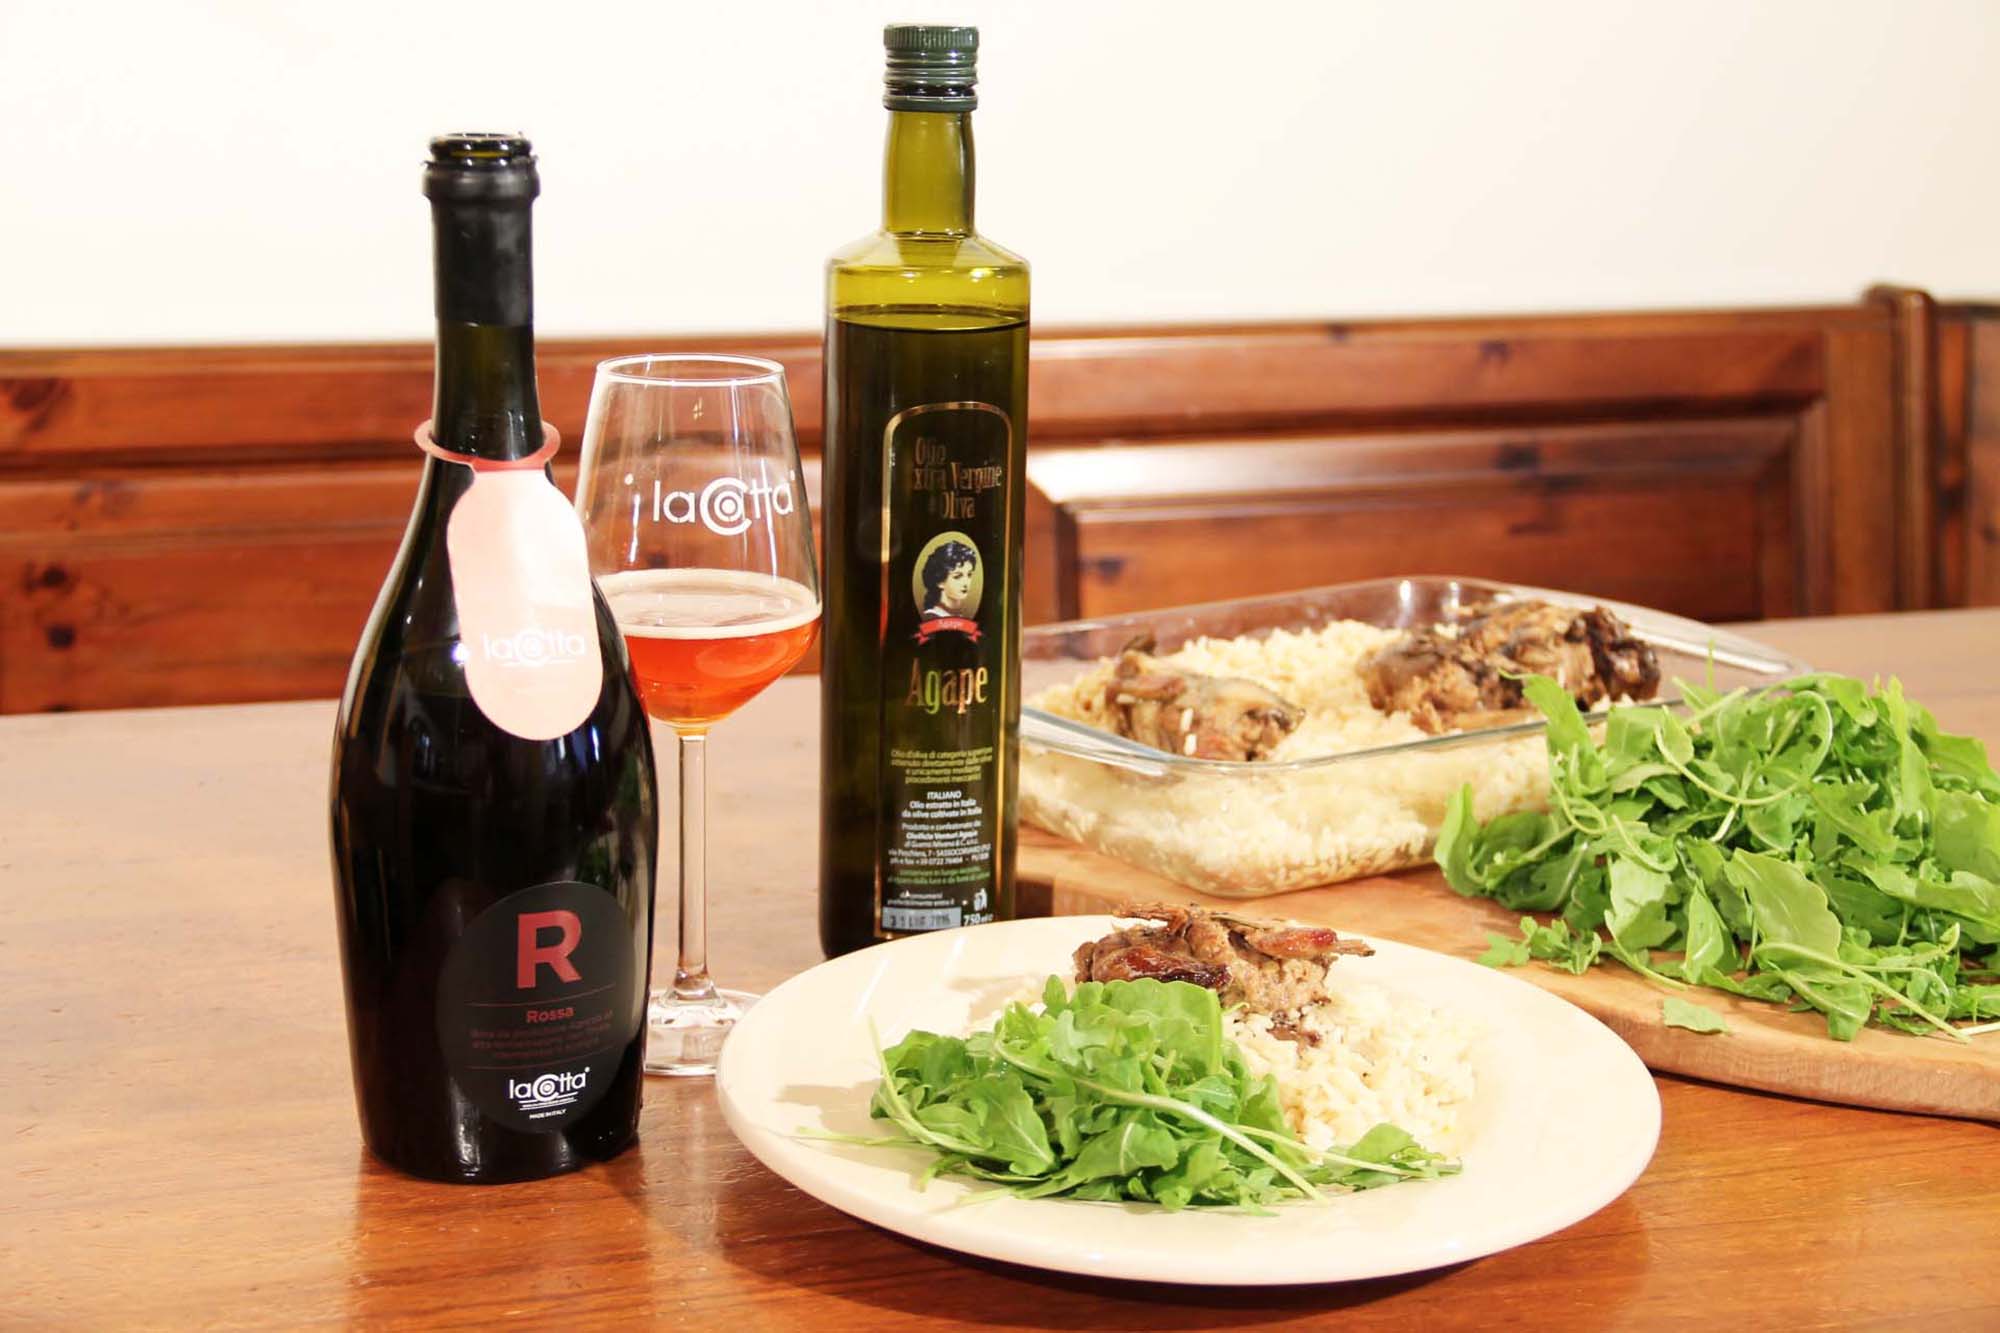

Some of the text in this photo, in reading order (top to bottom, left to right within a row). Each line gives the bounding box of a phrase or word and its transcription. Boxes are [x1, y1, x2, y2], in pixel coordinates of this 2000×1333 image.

[904, 657, 988, 714] Agape
[927, 791, 962, 799] ITALIANO
[517, 909, 582, 989] R
[526, 1007, 574, 1023] Rossa
